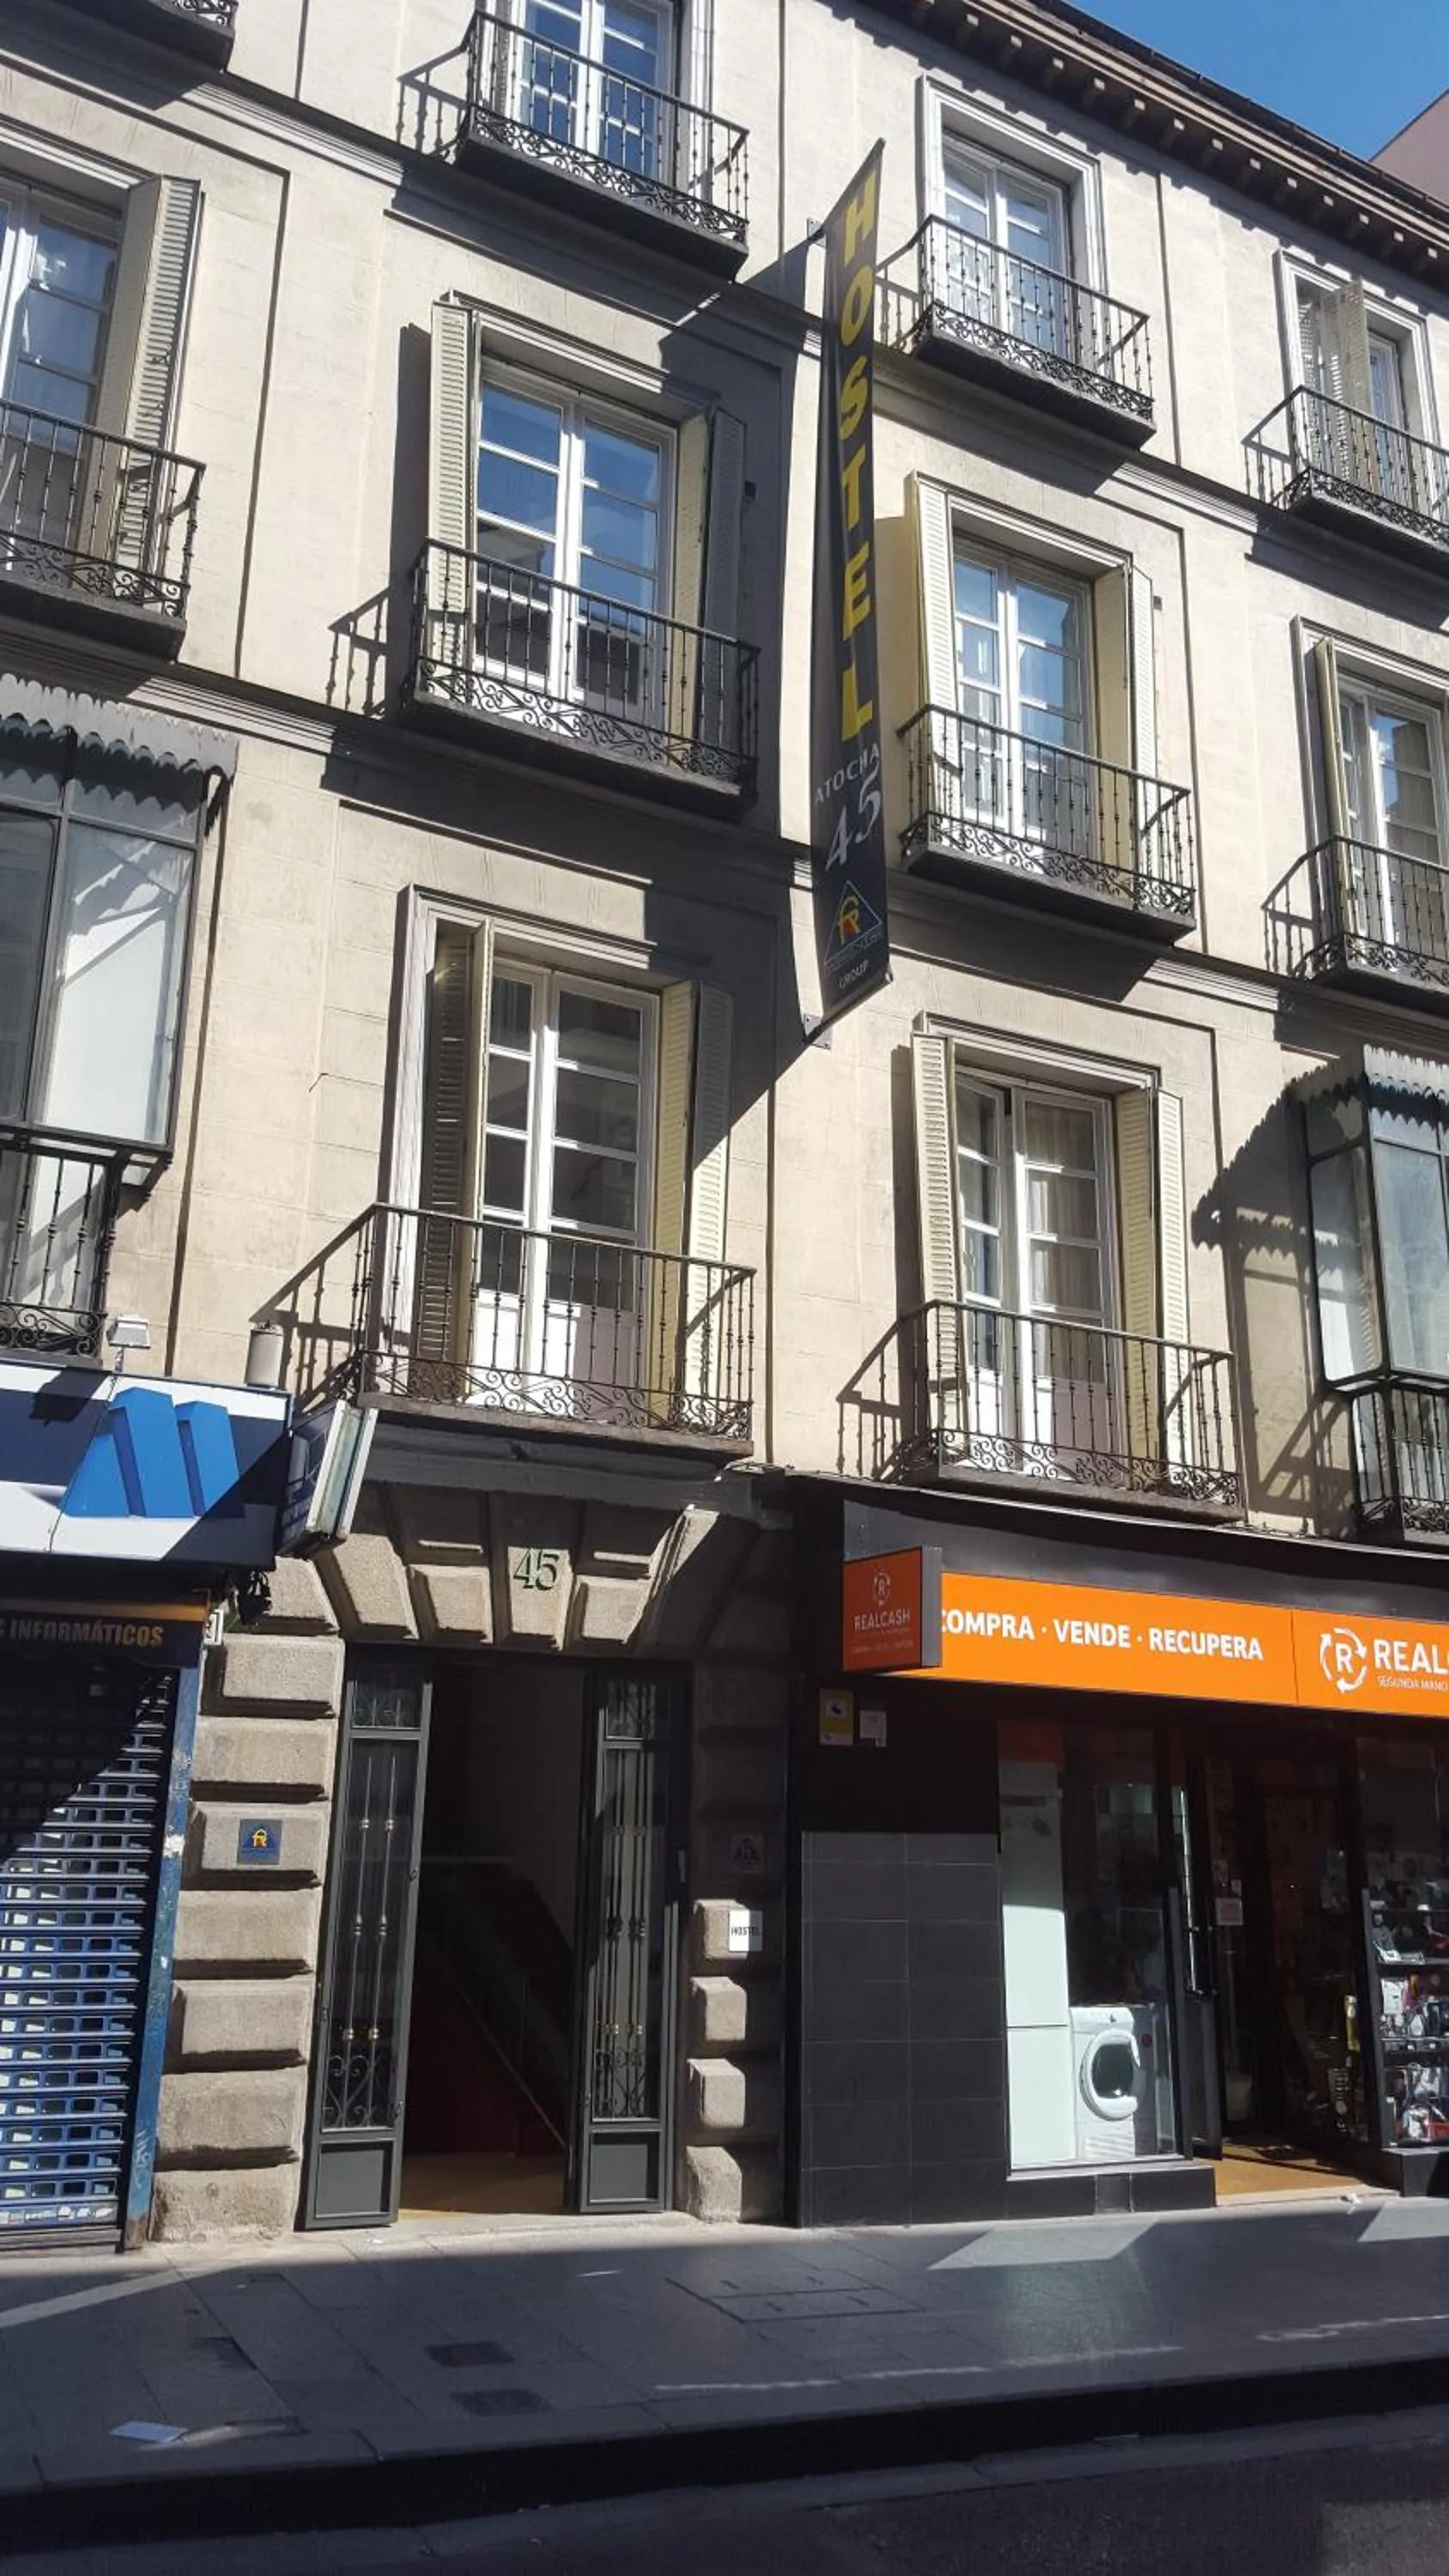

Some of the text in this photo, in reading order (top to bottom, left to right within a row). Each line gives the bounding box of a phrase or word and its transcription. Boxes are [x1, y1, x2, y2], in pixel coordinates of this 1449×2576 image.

[840, 178, 873, 741] HOSTEL
[814, 742, 880, 806] ATOCHA
[824, 759, 882, 872] 45
[512, 1547, 560, 1591] 45
[9, 1619, 165, 1648] INFORMÁTICOS
[853, 1608, 911, 1631] REALCASH
[1052, 1618, 1131, 1649] VENDE
[1148, 1626, 1264, 1662] RECUPERA
[1373, 1637, 1449, 1675] REAL
